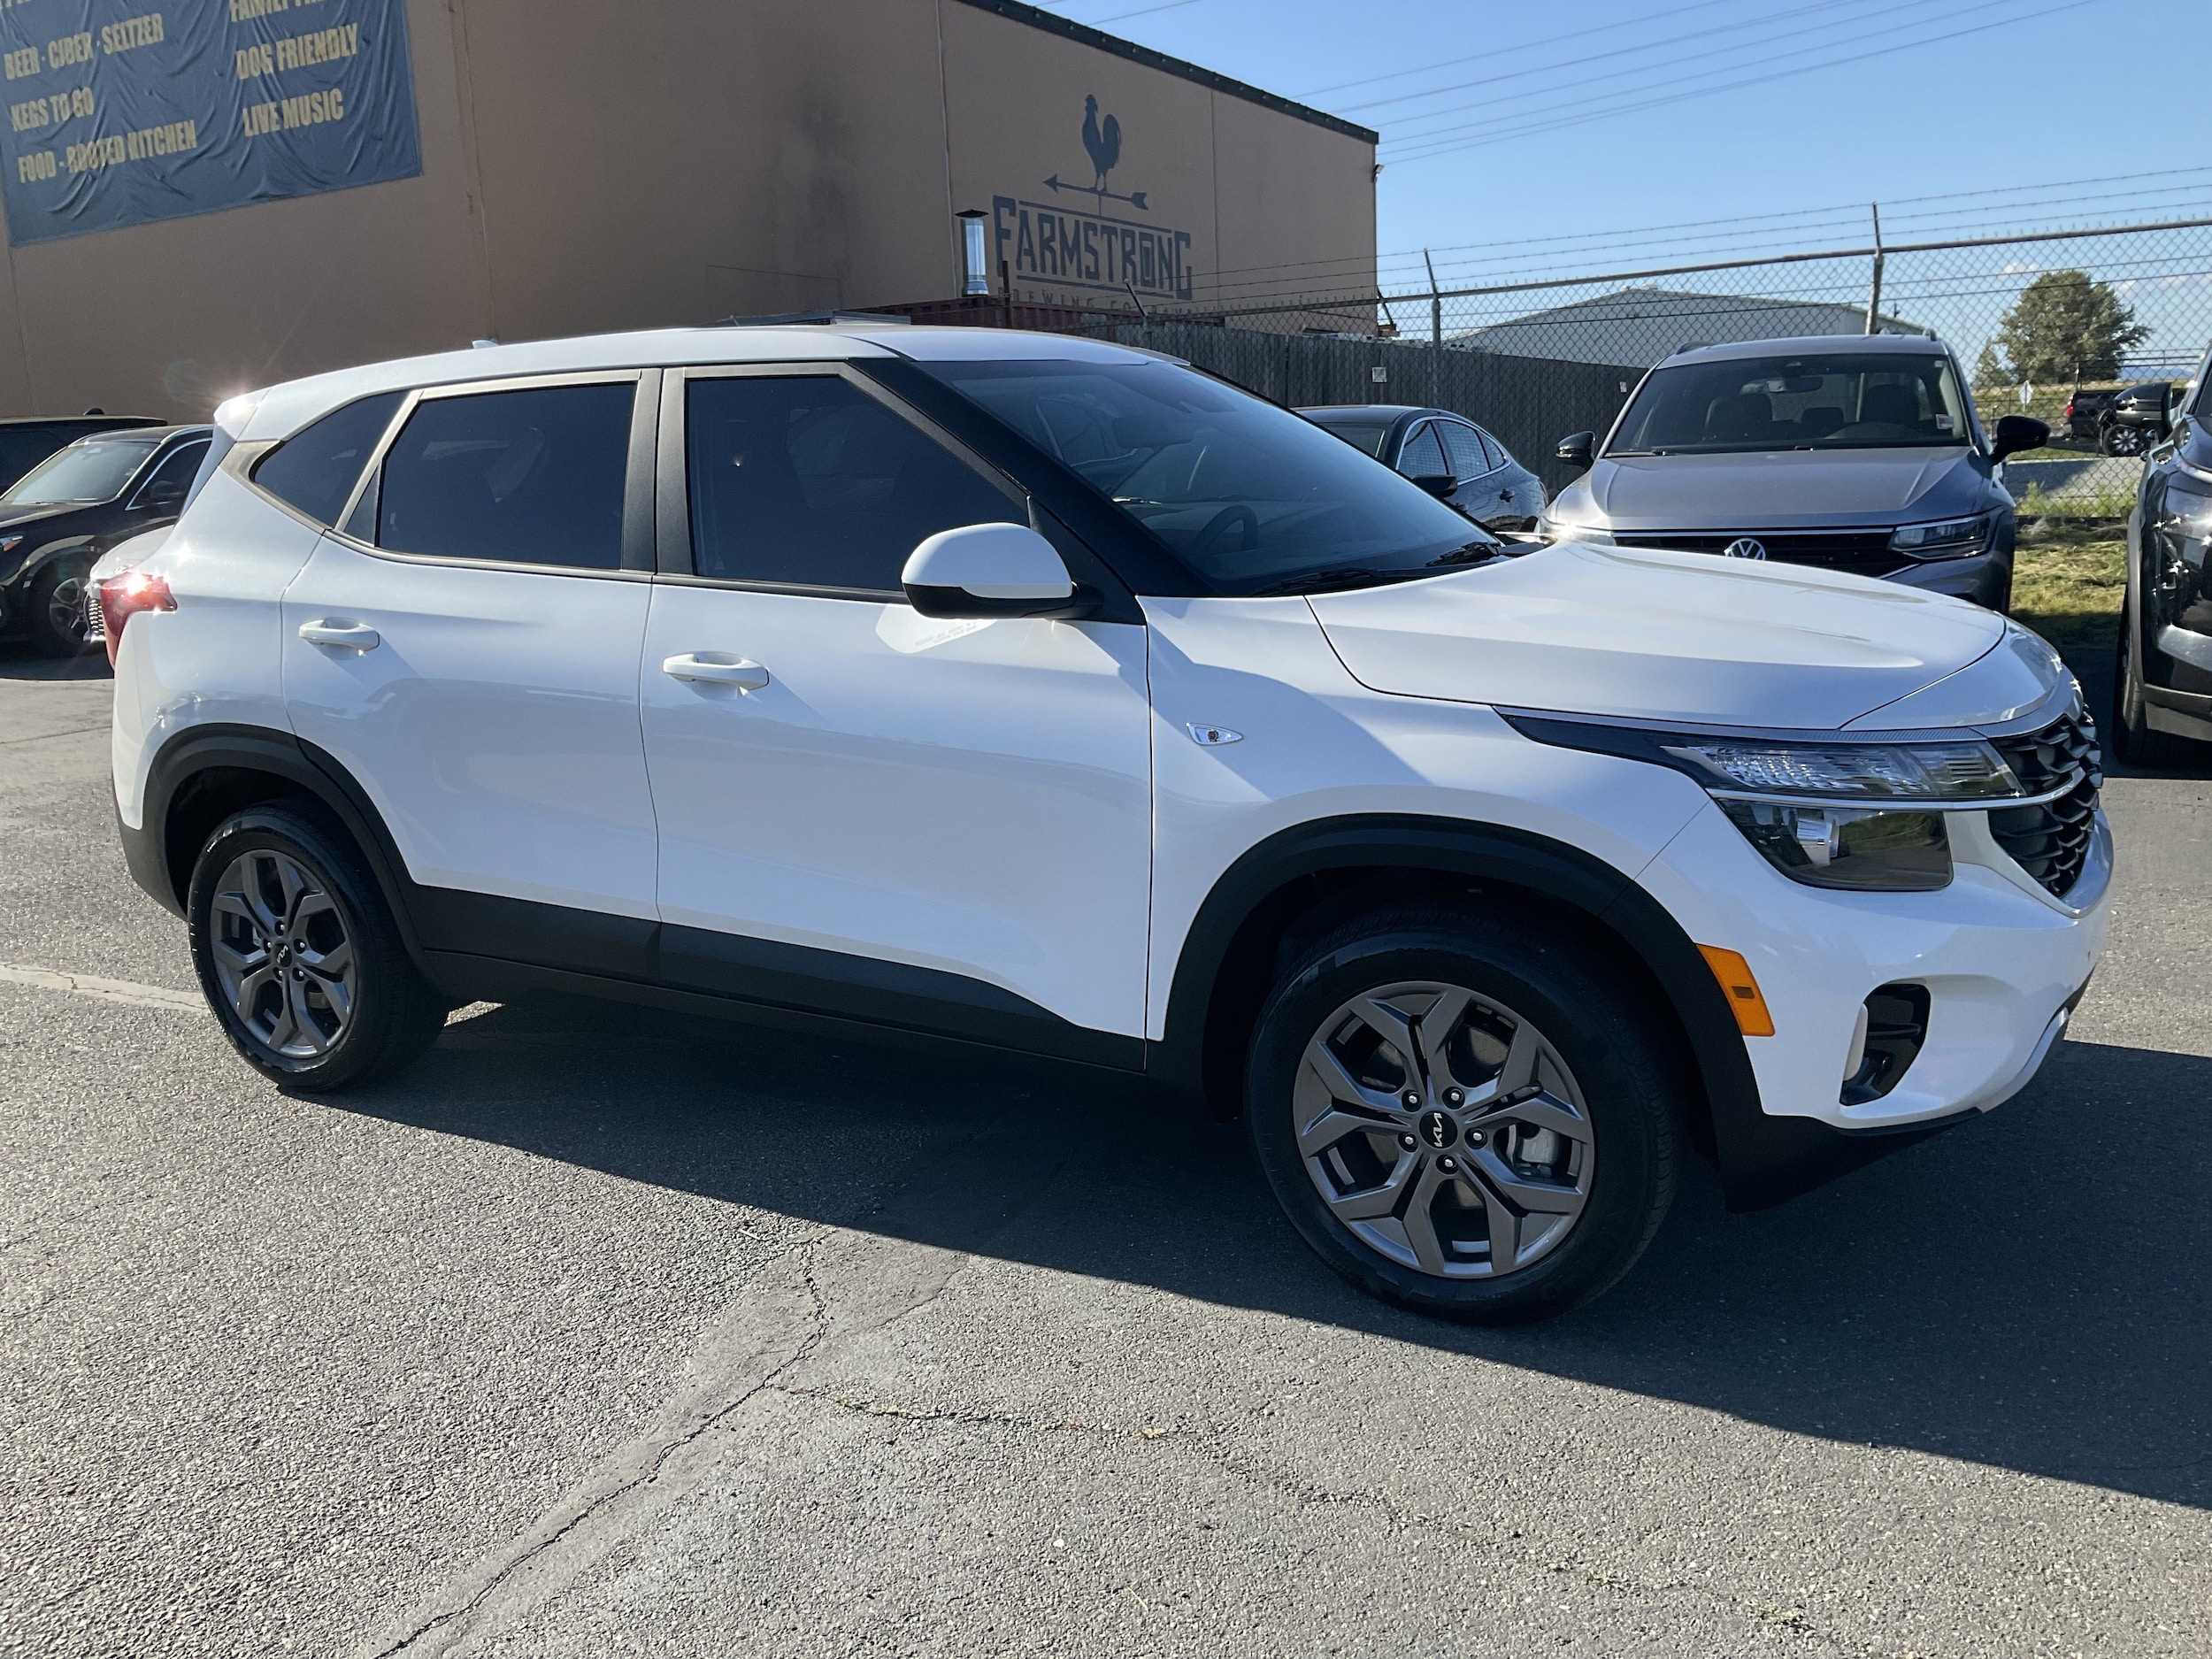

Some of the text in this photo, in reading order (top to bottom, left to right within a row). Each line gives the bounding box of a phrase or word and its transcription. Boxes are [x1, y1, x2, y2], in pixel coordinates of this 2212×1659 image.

[4, 13, 165, 81] BEER CIDER SELTZER
[236, 22, 357, 80] DOG FRIENDLY
[11, 87, 94, 132] KEGS TO GO
[242, 88, 343, 137] LIVE MUSIC
[18, 150, 56, 183] FOOD
[127, 119, 197, 160] KITCHEN
[992, 195, 1193, 301] FARMSTRONG
